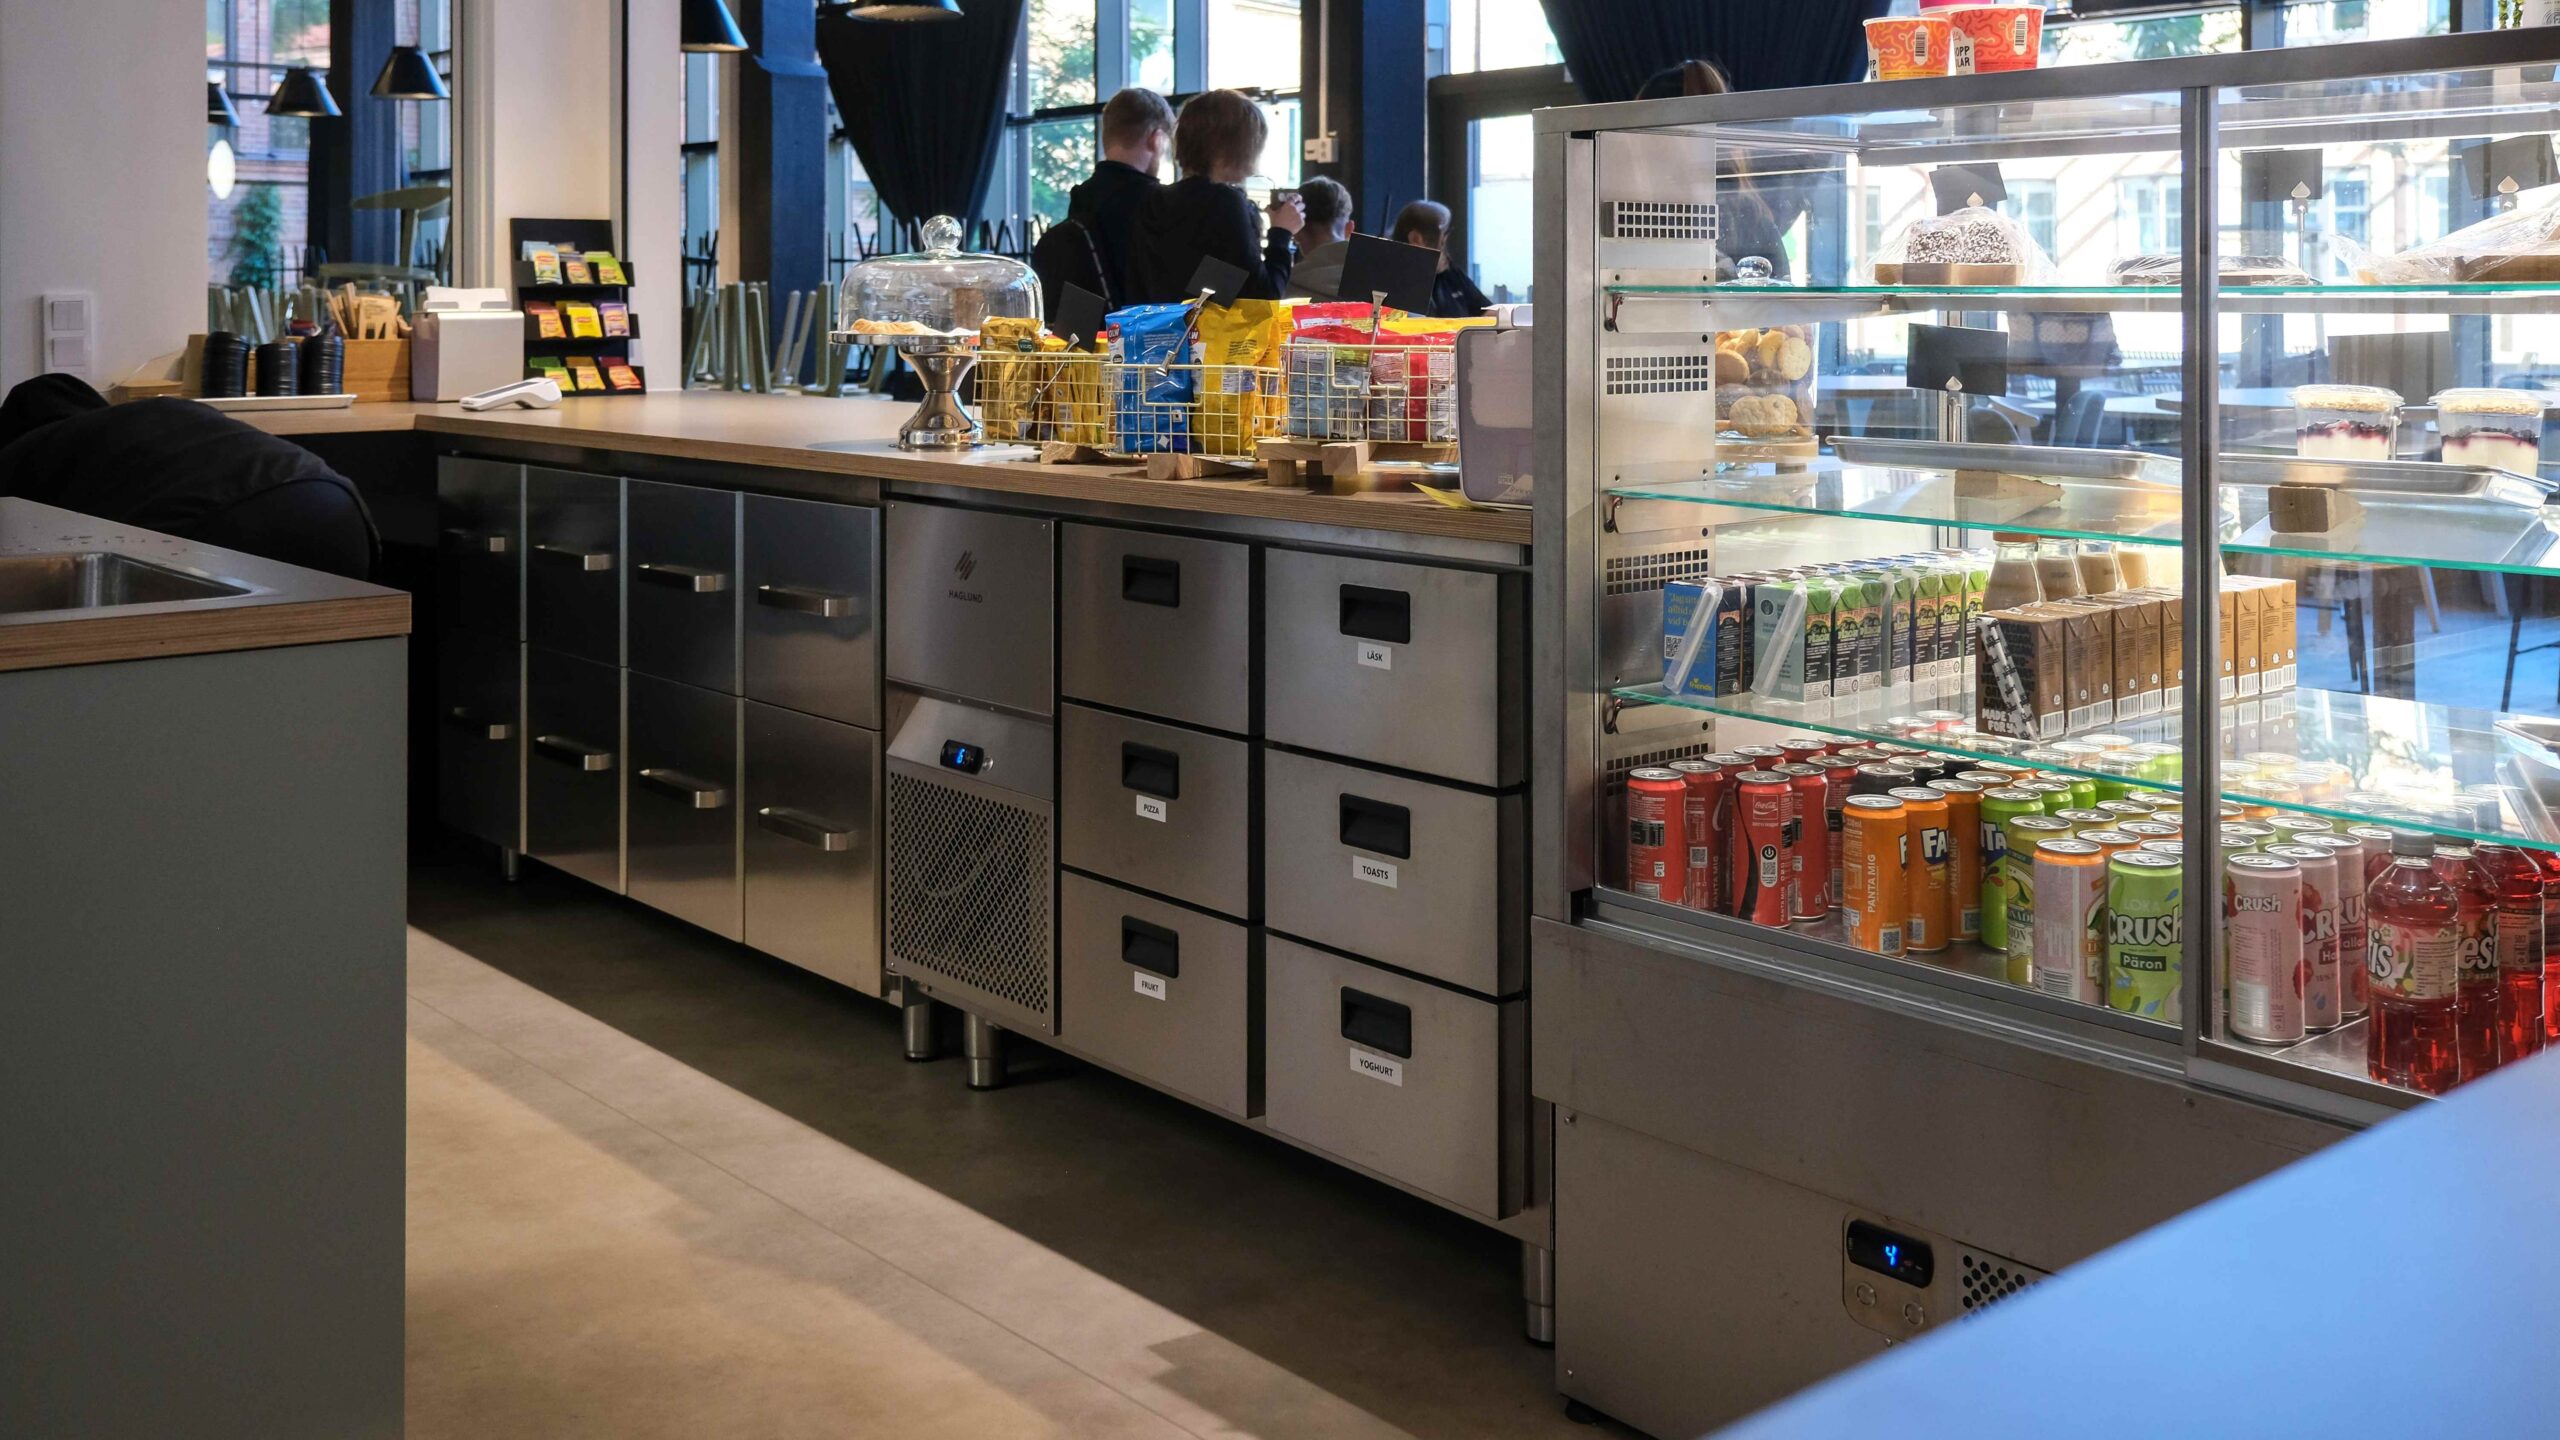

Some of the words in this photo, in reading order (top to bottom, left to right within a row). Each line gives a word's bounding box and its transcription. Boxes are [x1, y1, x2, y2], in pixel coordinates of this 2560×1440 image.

[948, 590, 983, 603] HAGLUND
[1982, 708, 2007, 722] MADE
[1144, 804, 1159, 815] PIZZA
[1362, 865, 1389, 880] TOASTS
[1867, 854, 1876, 877] MIG
[1867, 878, 1876, 913] PANTA
[2122, 955, 2163, 970] Päron
[1359, 1057, 1394, 1077] YOGHURT
[1885, 1244, 1897, 1266] 4
